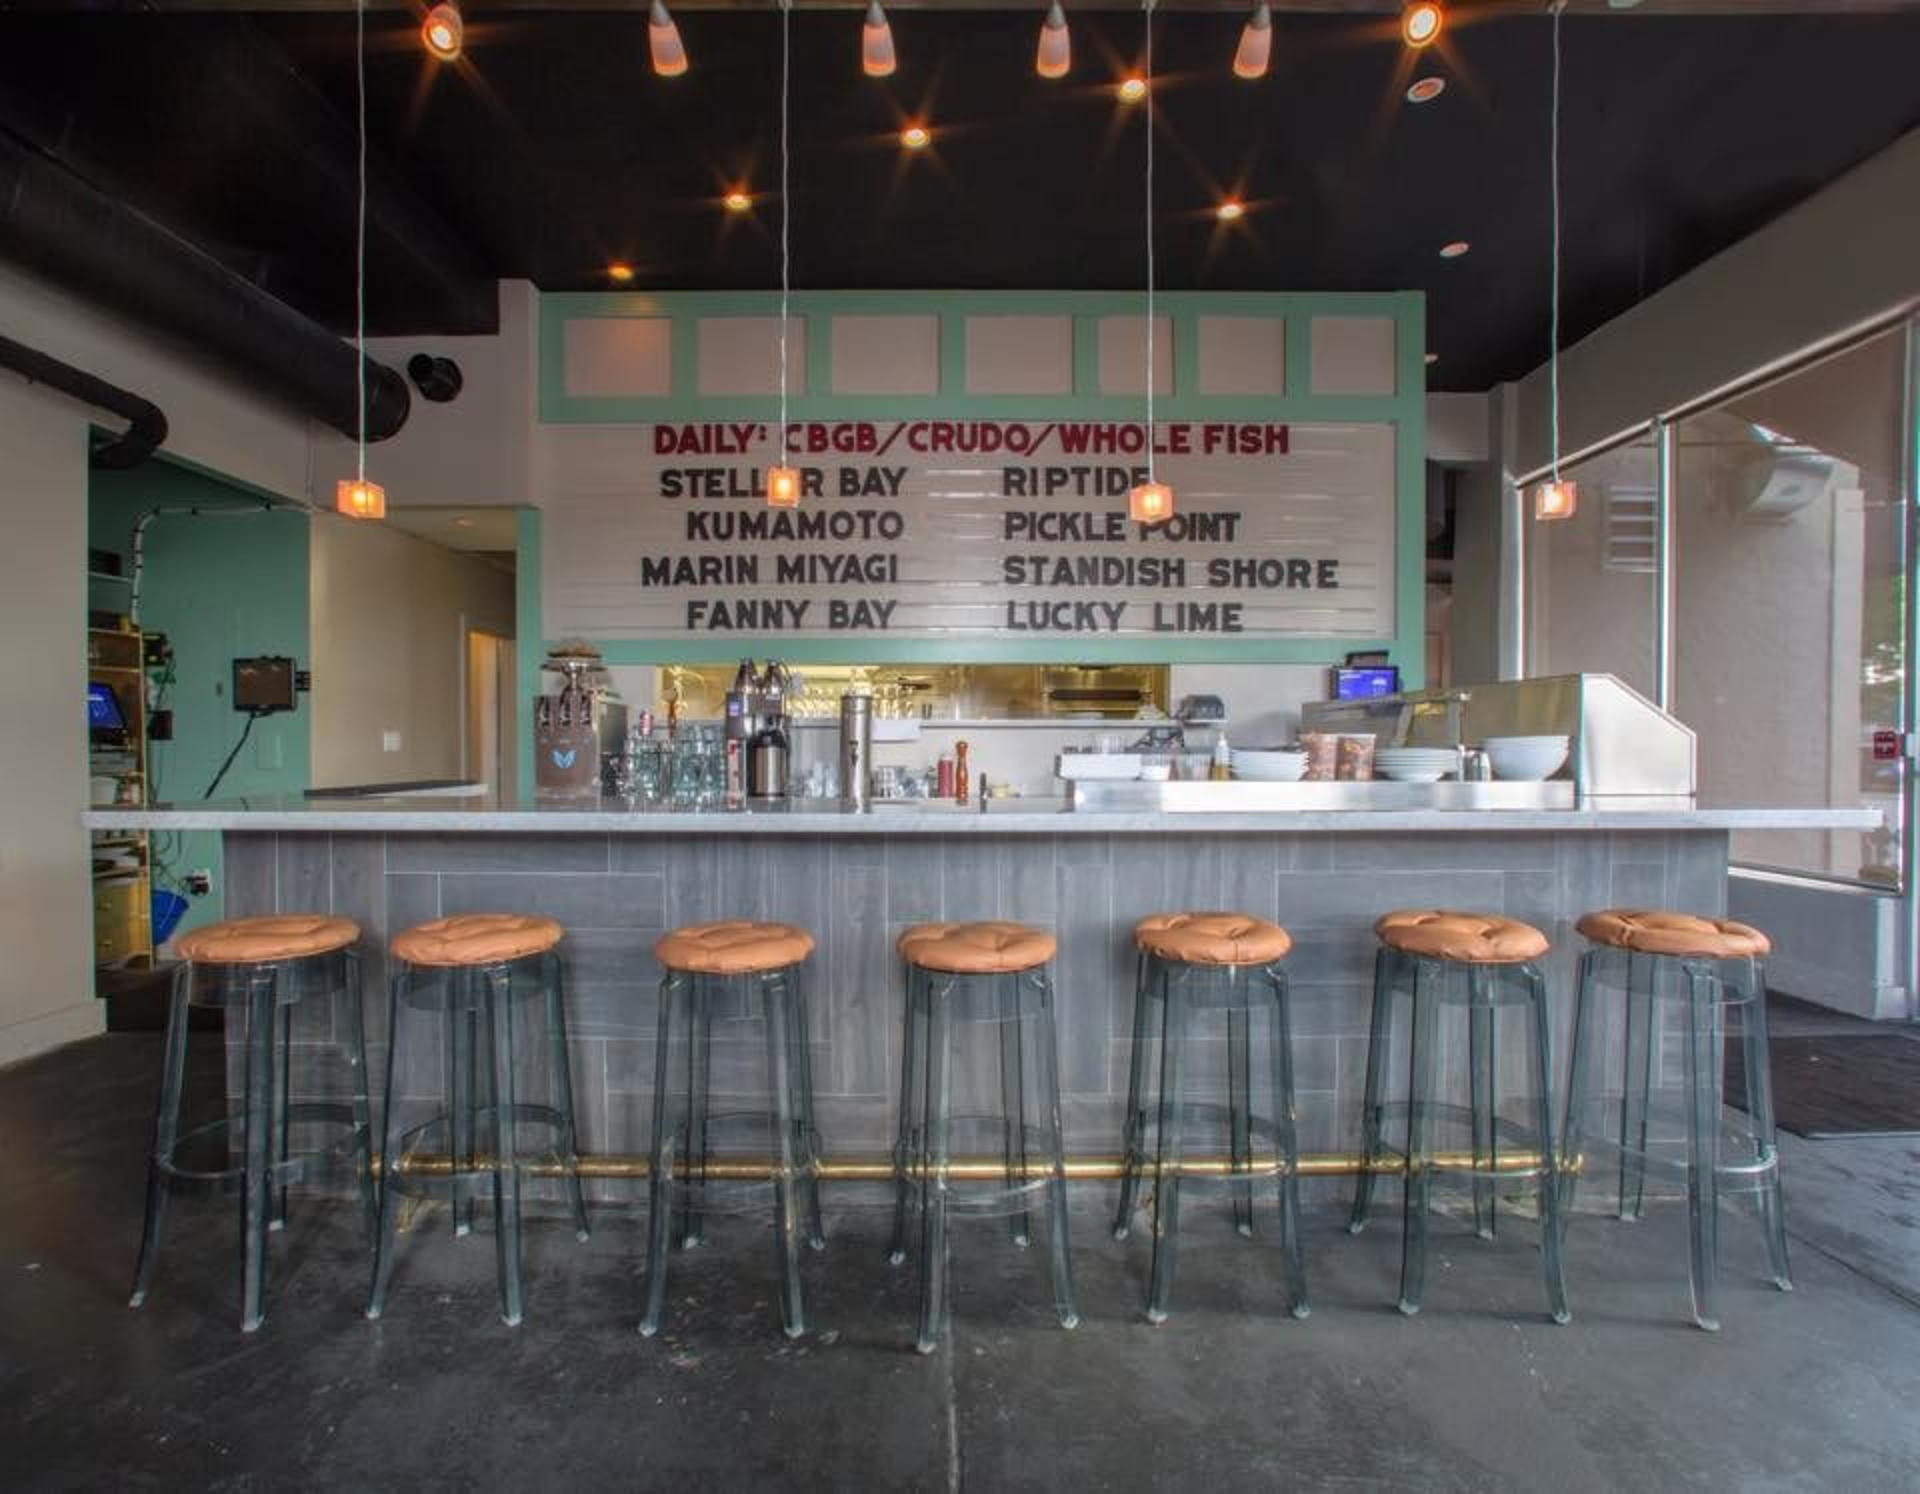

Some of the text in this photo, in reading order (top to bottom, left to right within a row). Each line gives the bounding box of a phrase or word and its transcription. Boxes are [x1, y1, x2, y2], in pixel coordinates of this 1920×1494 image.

[653, 423, 767, 455] DAILY:
[1203, 423, 1290, 455] FISH
[659, 466, 908, 498] STELLR BAY
[686, 509, 905, 542] KUMAMOTO
[1004, 511, 1127, 542] PICKLE
[641, 553, 898, 587] MARIN MIYAGI
[1004, 556, 1340, 589] STANDISH SHORE
[687, 600, 897, 630] FANNY BAY
[1007, 601, 1244, 632] LUCKY LIME
